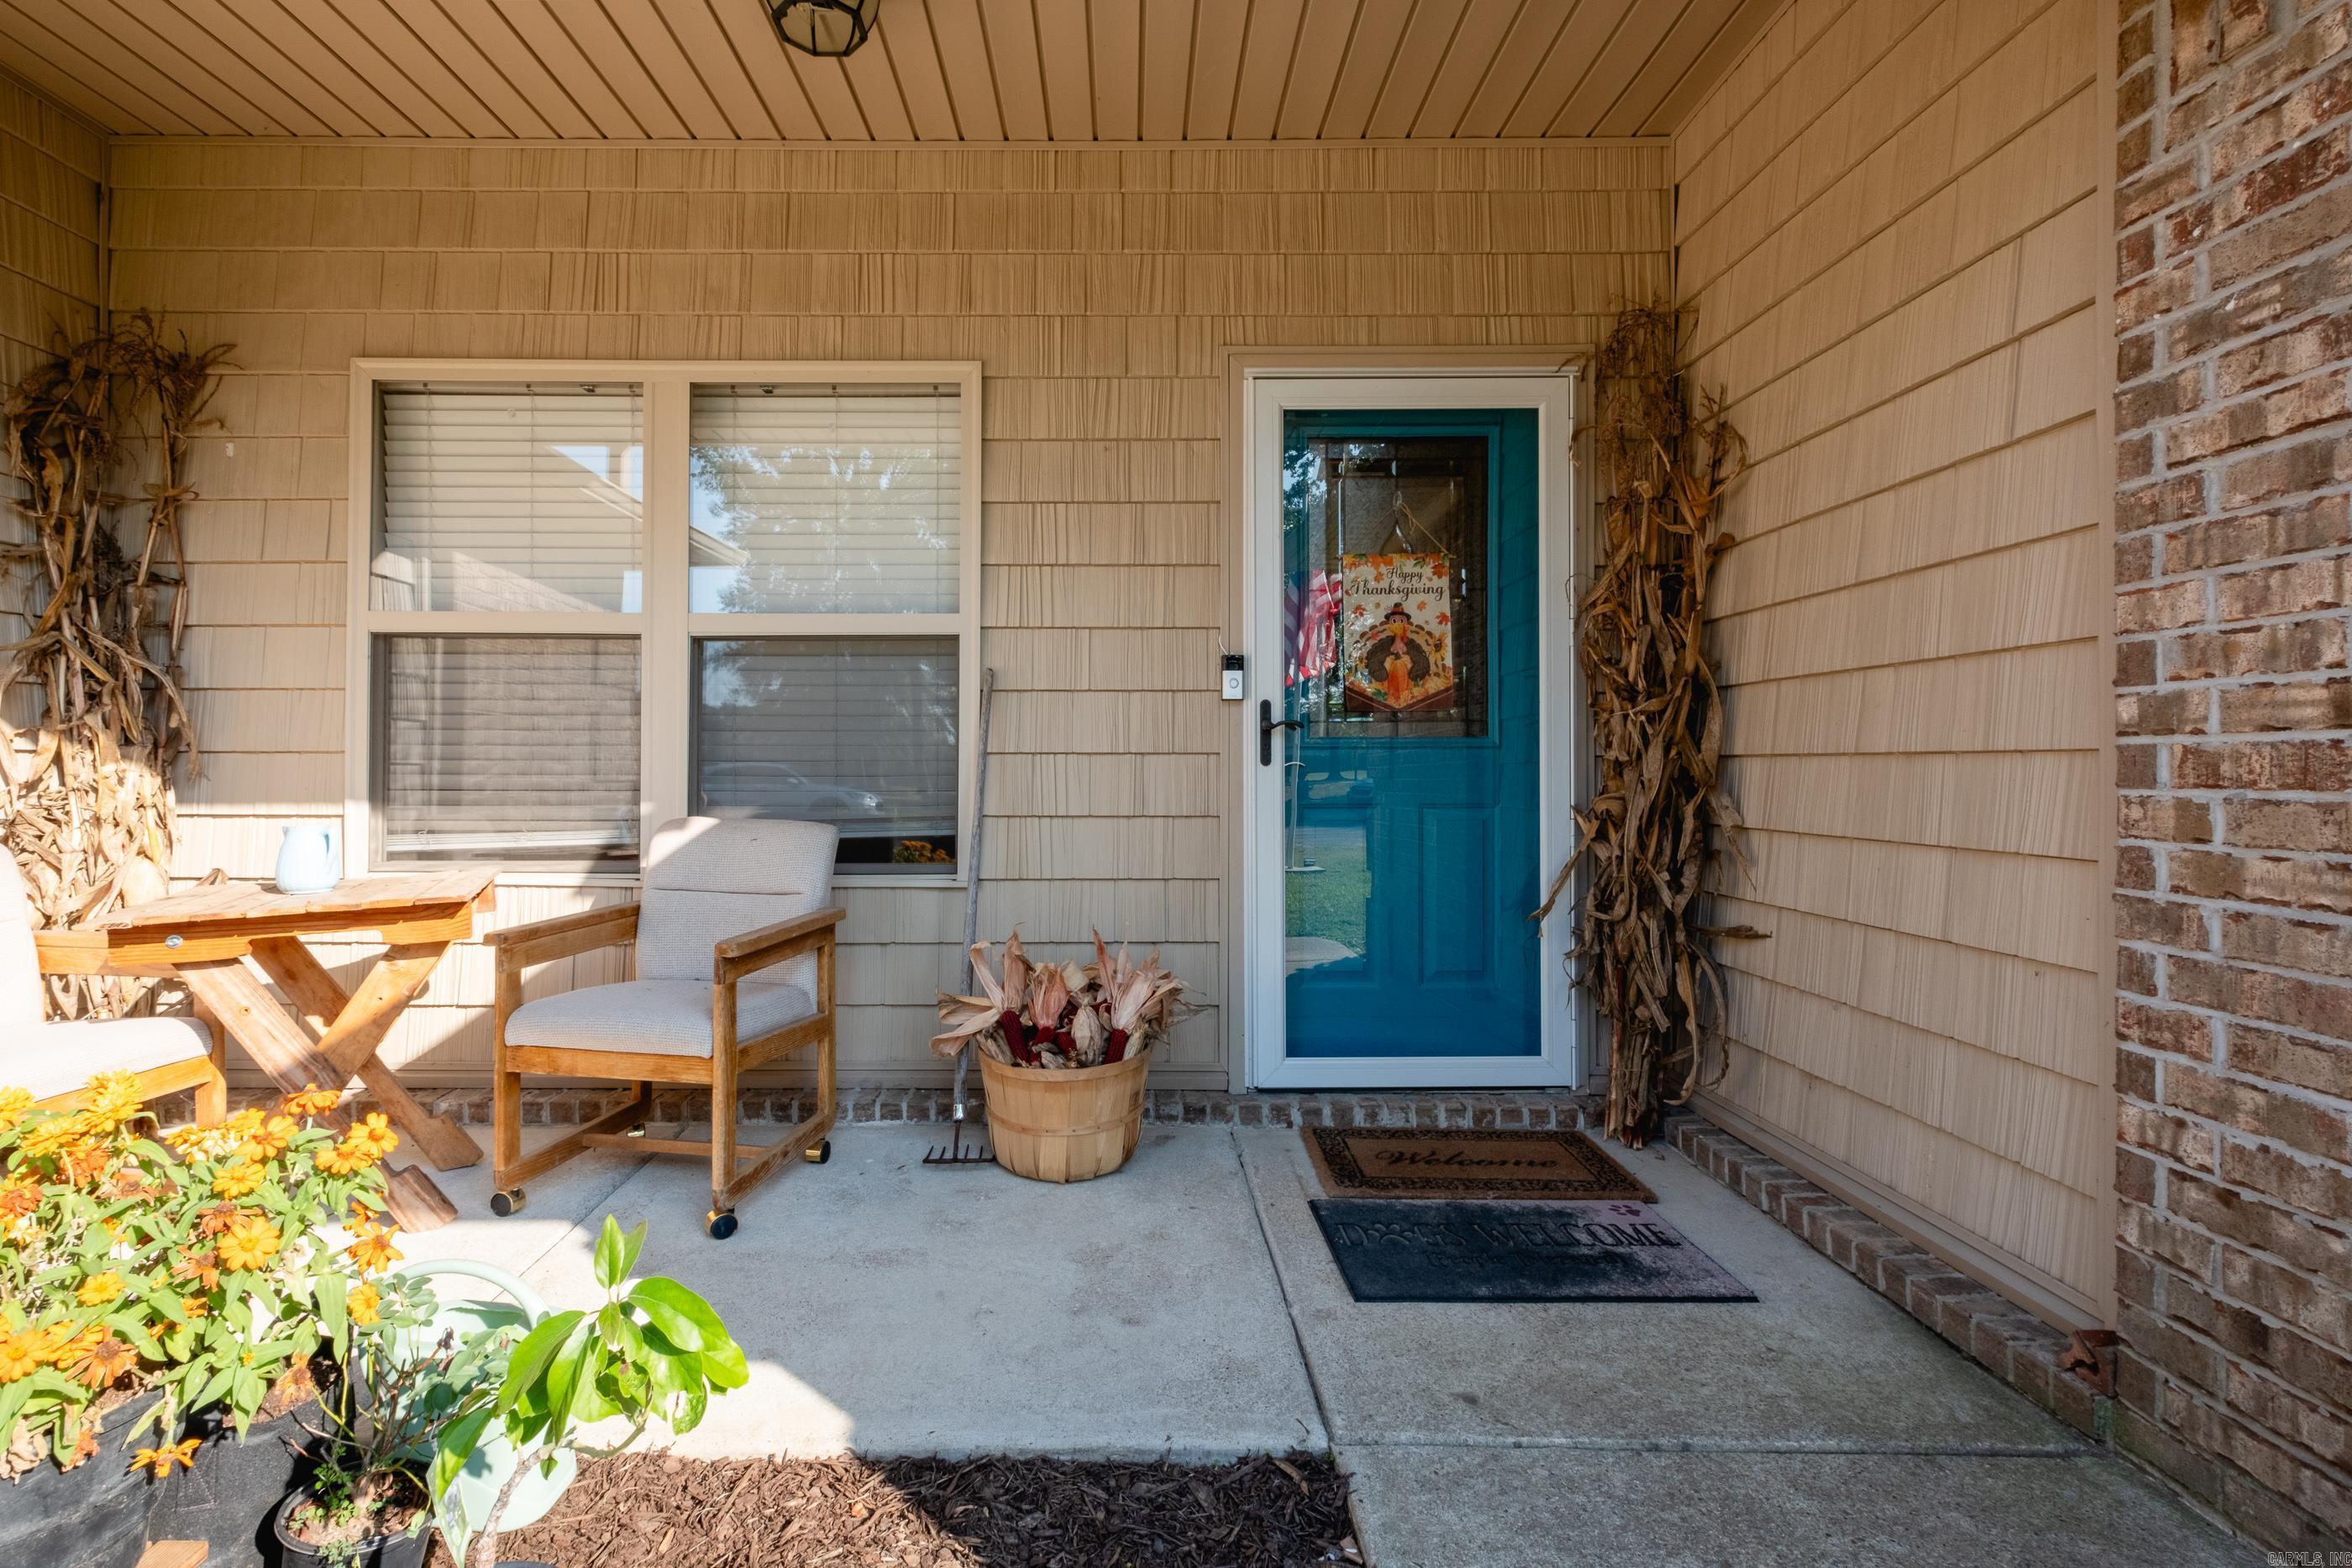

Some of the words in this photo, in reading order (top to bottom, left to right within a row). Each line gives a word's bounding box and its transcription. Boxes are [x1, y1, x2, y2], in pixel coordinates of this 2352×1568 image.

[1385, 566, 1424, 584] Happy
[1350, 578, 1445, 601] Thanksgiving
[1374, 1149, 1559, 1169] Welcome
[1473, 1222, 1682, 1248] WELCOME
